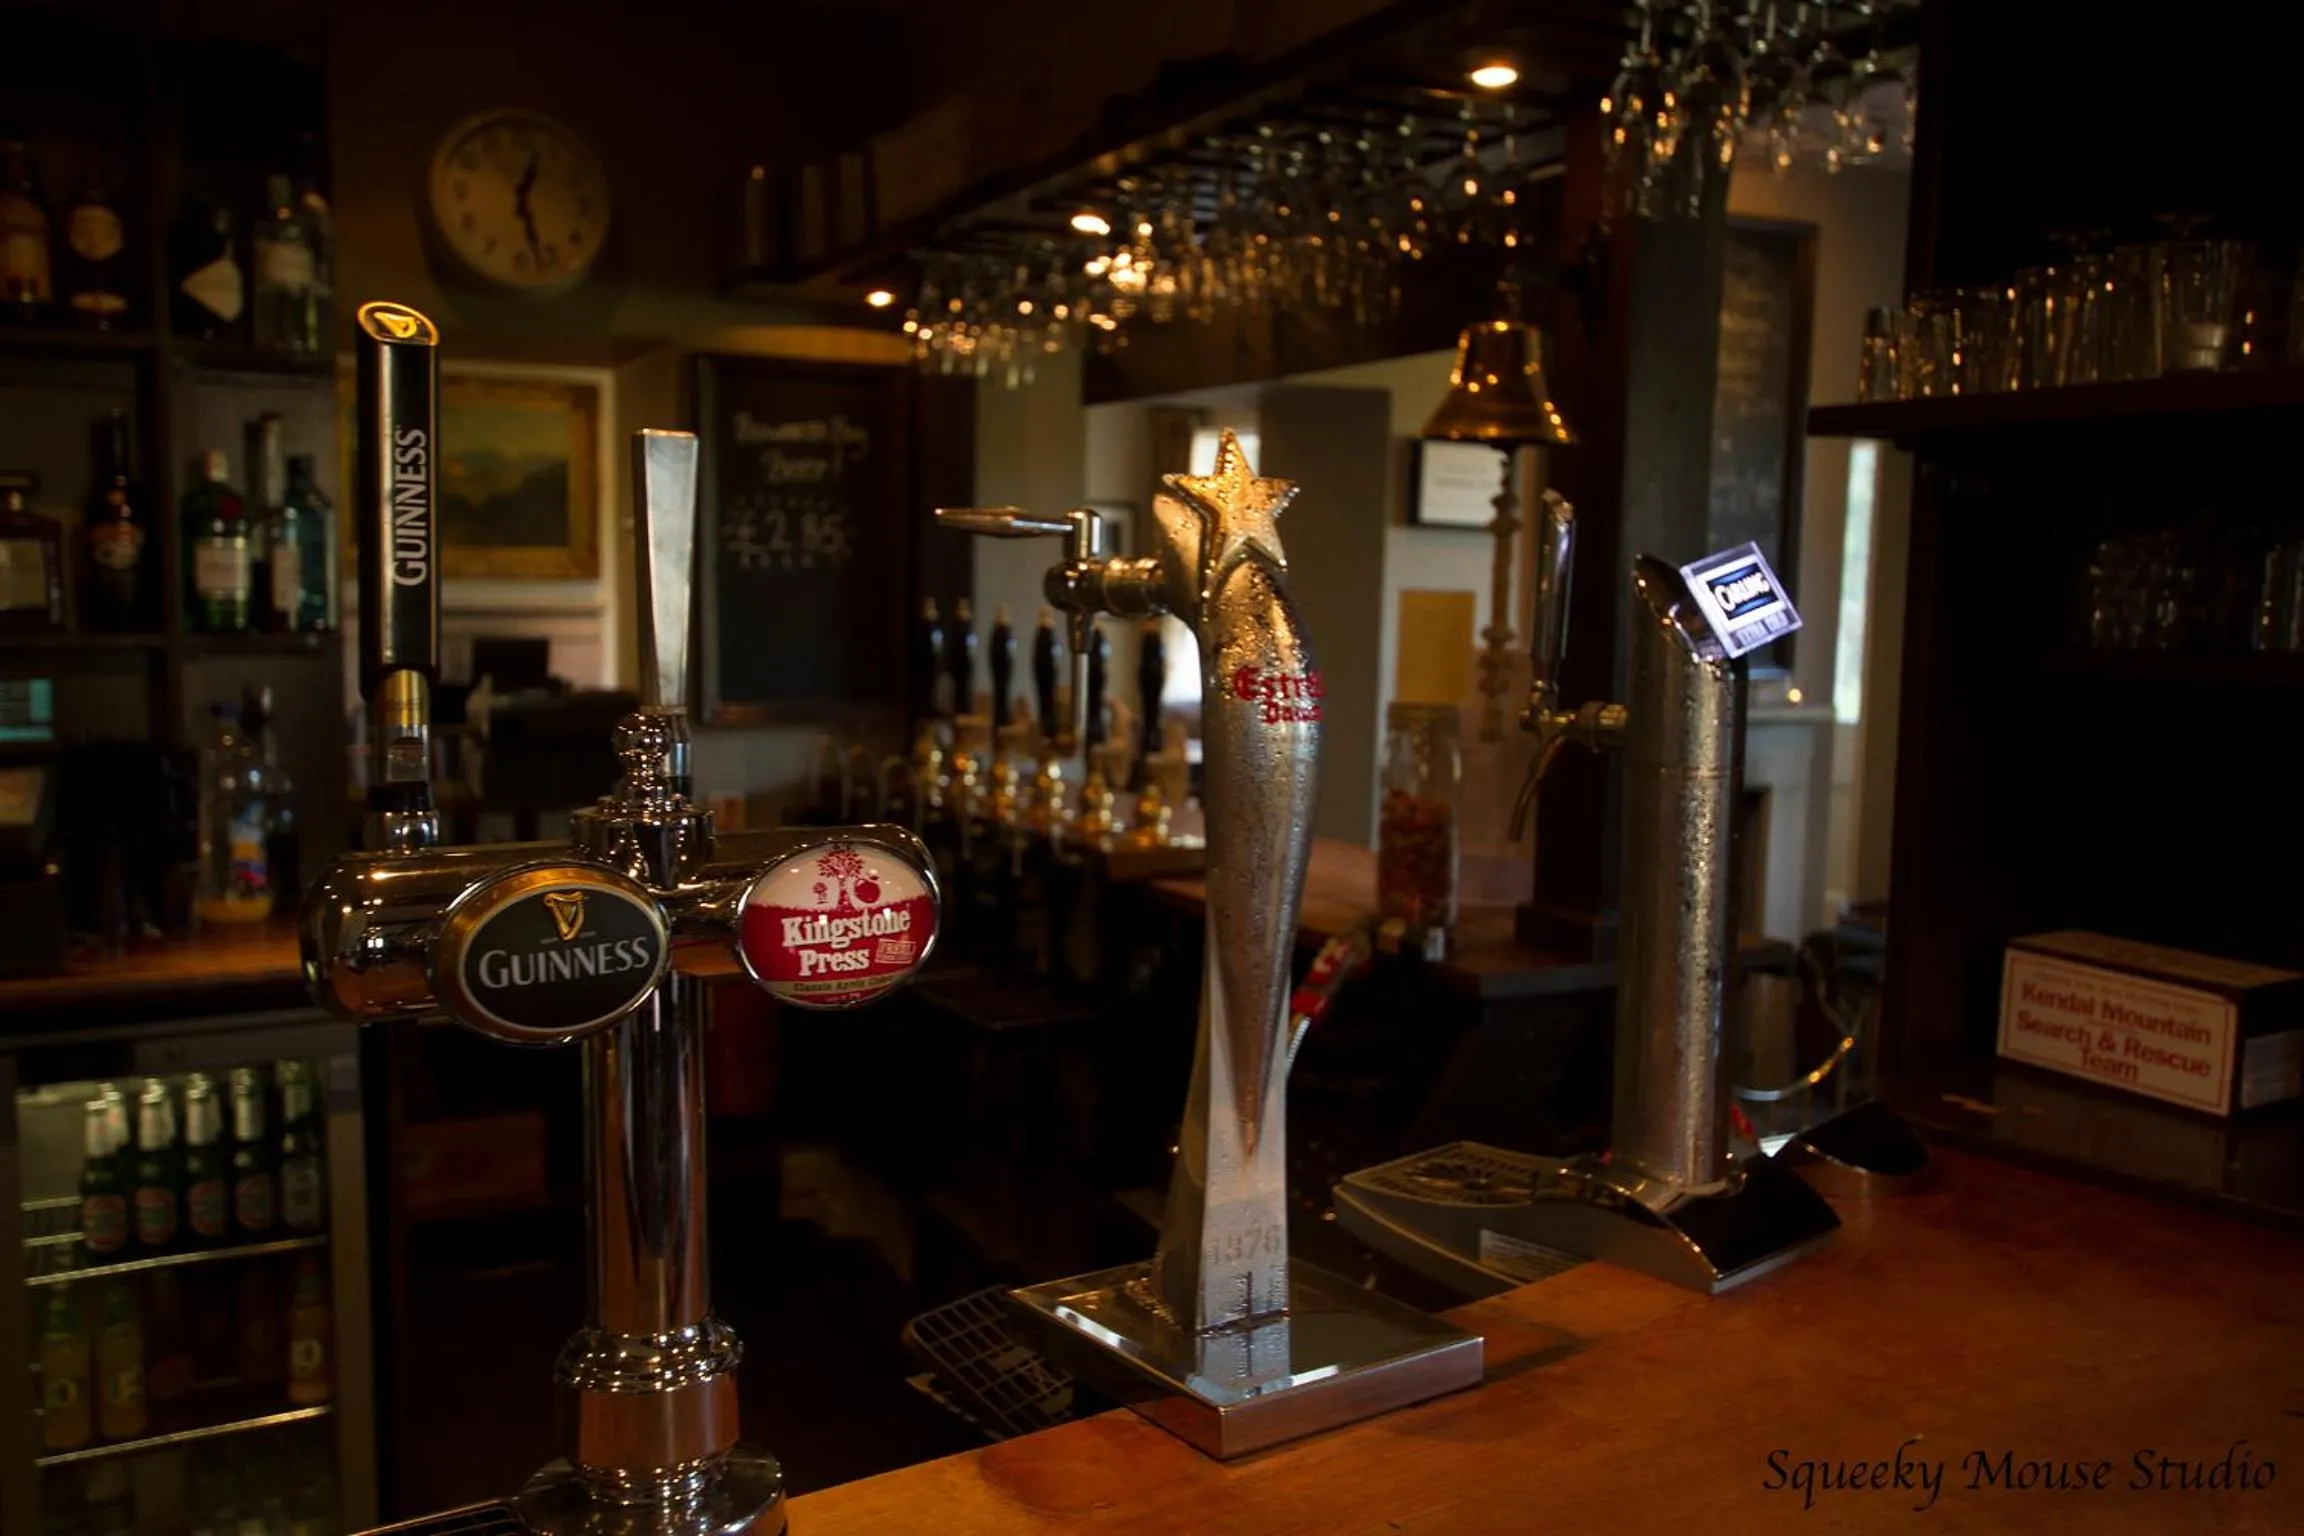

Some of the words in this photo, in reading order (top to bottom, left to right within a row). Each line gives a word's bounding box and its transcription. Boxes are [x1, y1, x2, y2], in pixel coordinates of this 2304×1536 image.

[394, 427, 428, 587] GUINNESS
[780, 907, 912, 950] Kingstone
[478, 936, 650, 989] GUINNESS
[798, 948, 871, 977] Press
[2021, 981, 2095, 1017] Kendal
[2102, 1001, 2212, 1045] Mountain
[2016, 1009, 2091, 1045] Search
[2097, 1030, 2118, 1054] &
[2123, 1036, 2212, 1078] Rescue
[2080, 1048, 2139, 1081] Team
